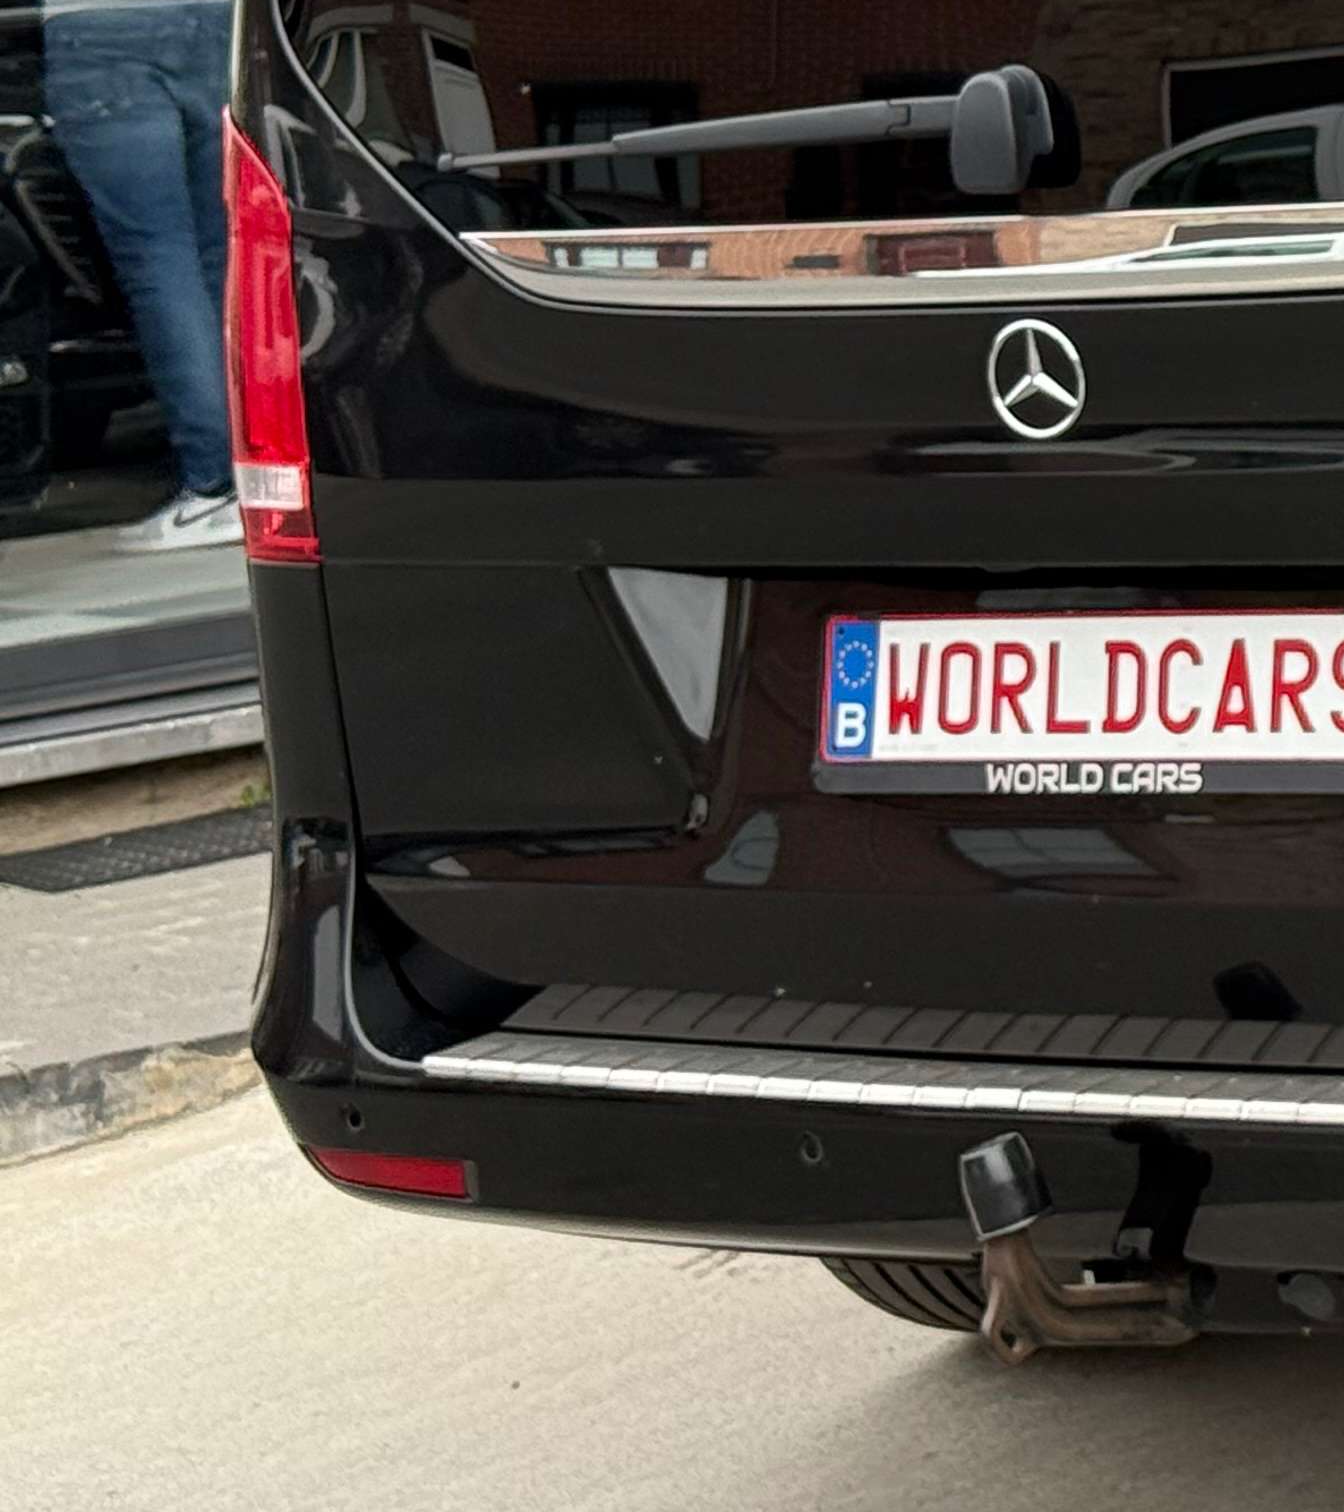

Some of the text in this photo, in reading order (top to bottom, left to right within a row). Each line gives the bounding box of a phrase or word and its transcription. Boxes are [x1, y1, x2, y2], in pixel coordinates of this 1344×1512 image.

[835, 702, 867, 748] B
[986, 762, 1203, 795] WORLD CARS
